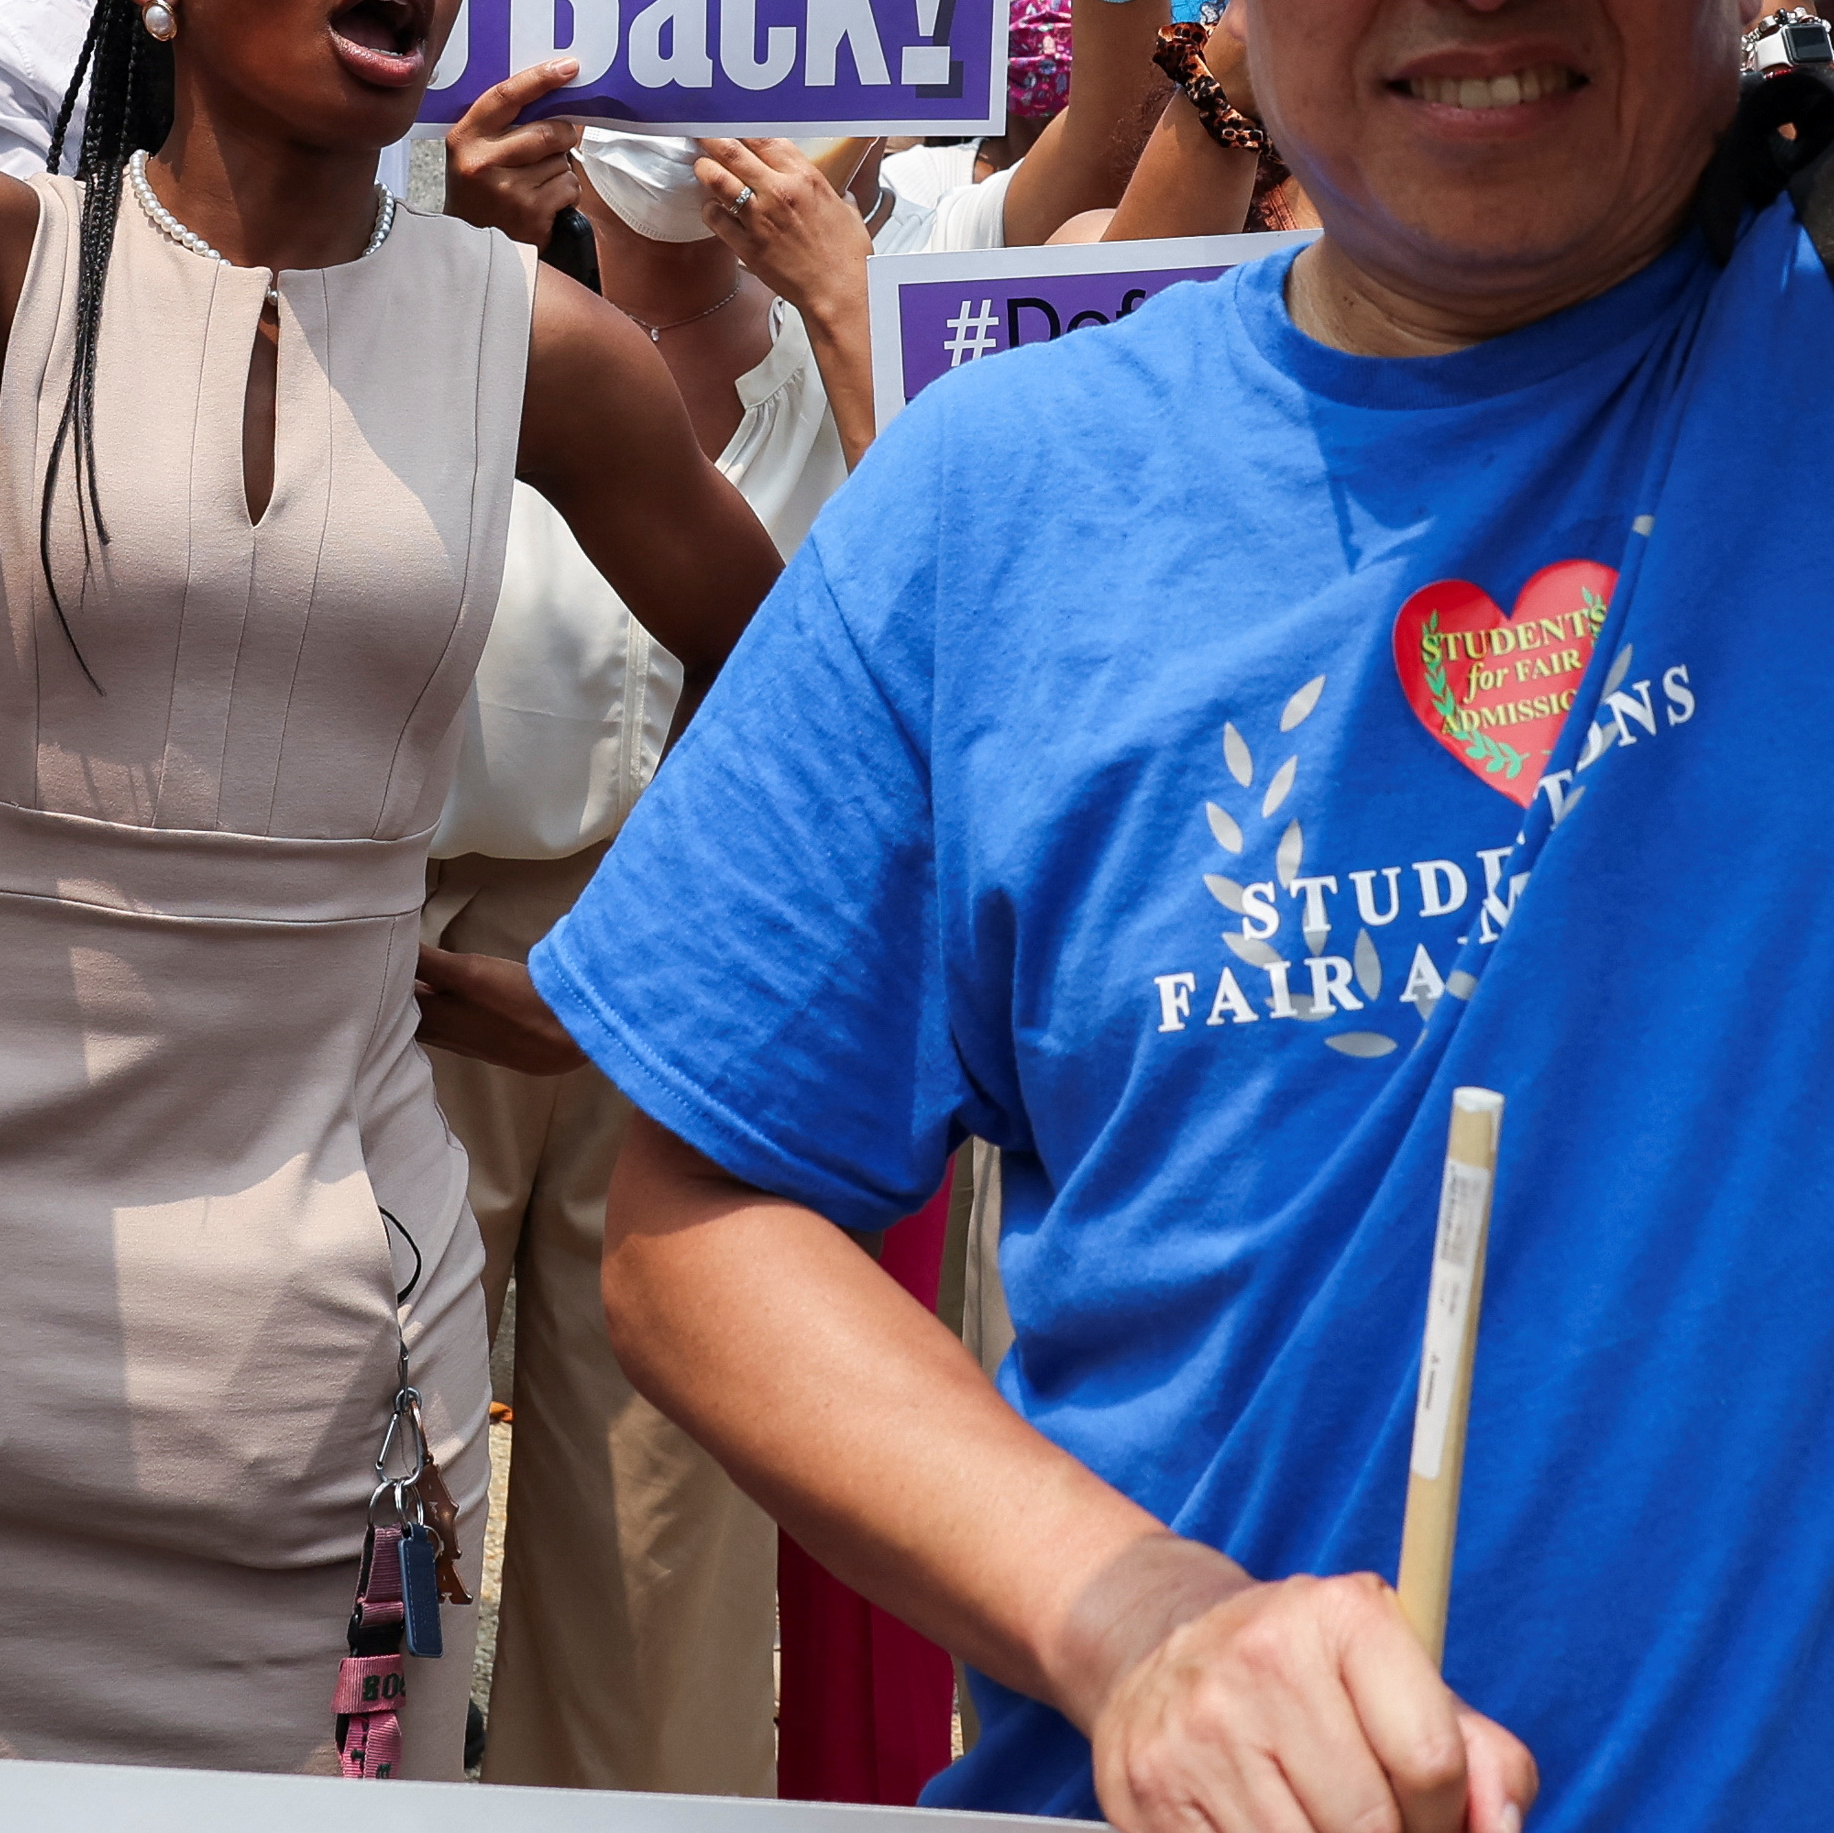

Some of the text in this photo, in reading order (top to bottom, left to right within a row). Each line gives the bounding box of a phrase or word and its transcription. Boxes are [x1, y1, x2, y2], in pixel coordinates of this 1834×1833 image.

[1420, 603, 1607, 663] STUDENTS
[1462, 649, 1583, 704] for FAIR
[1441, 688, 1577, 736] ADMISSIO
[1152, 954, 1364, 1033] FAIR
